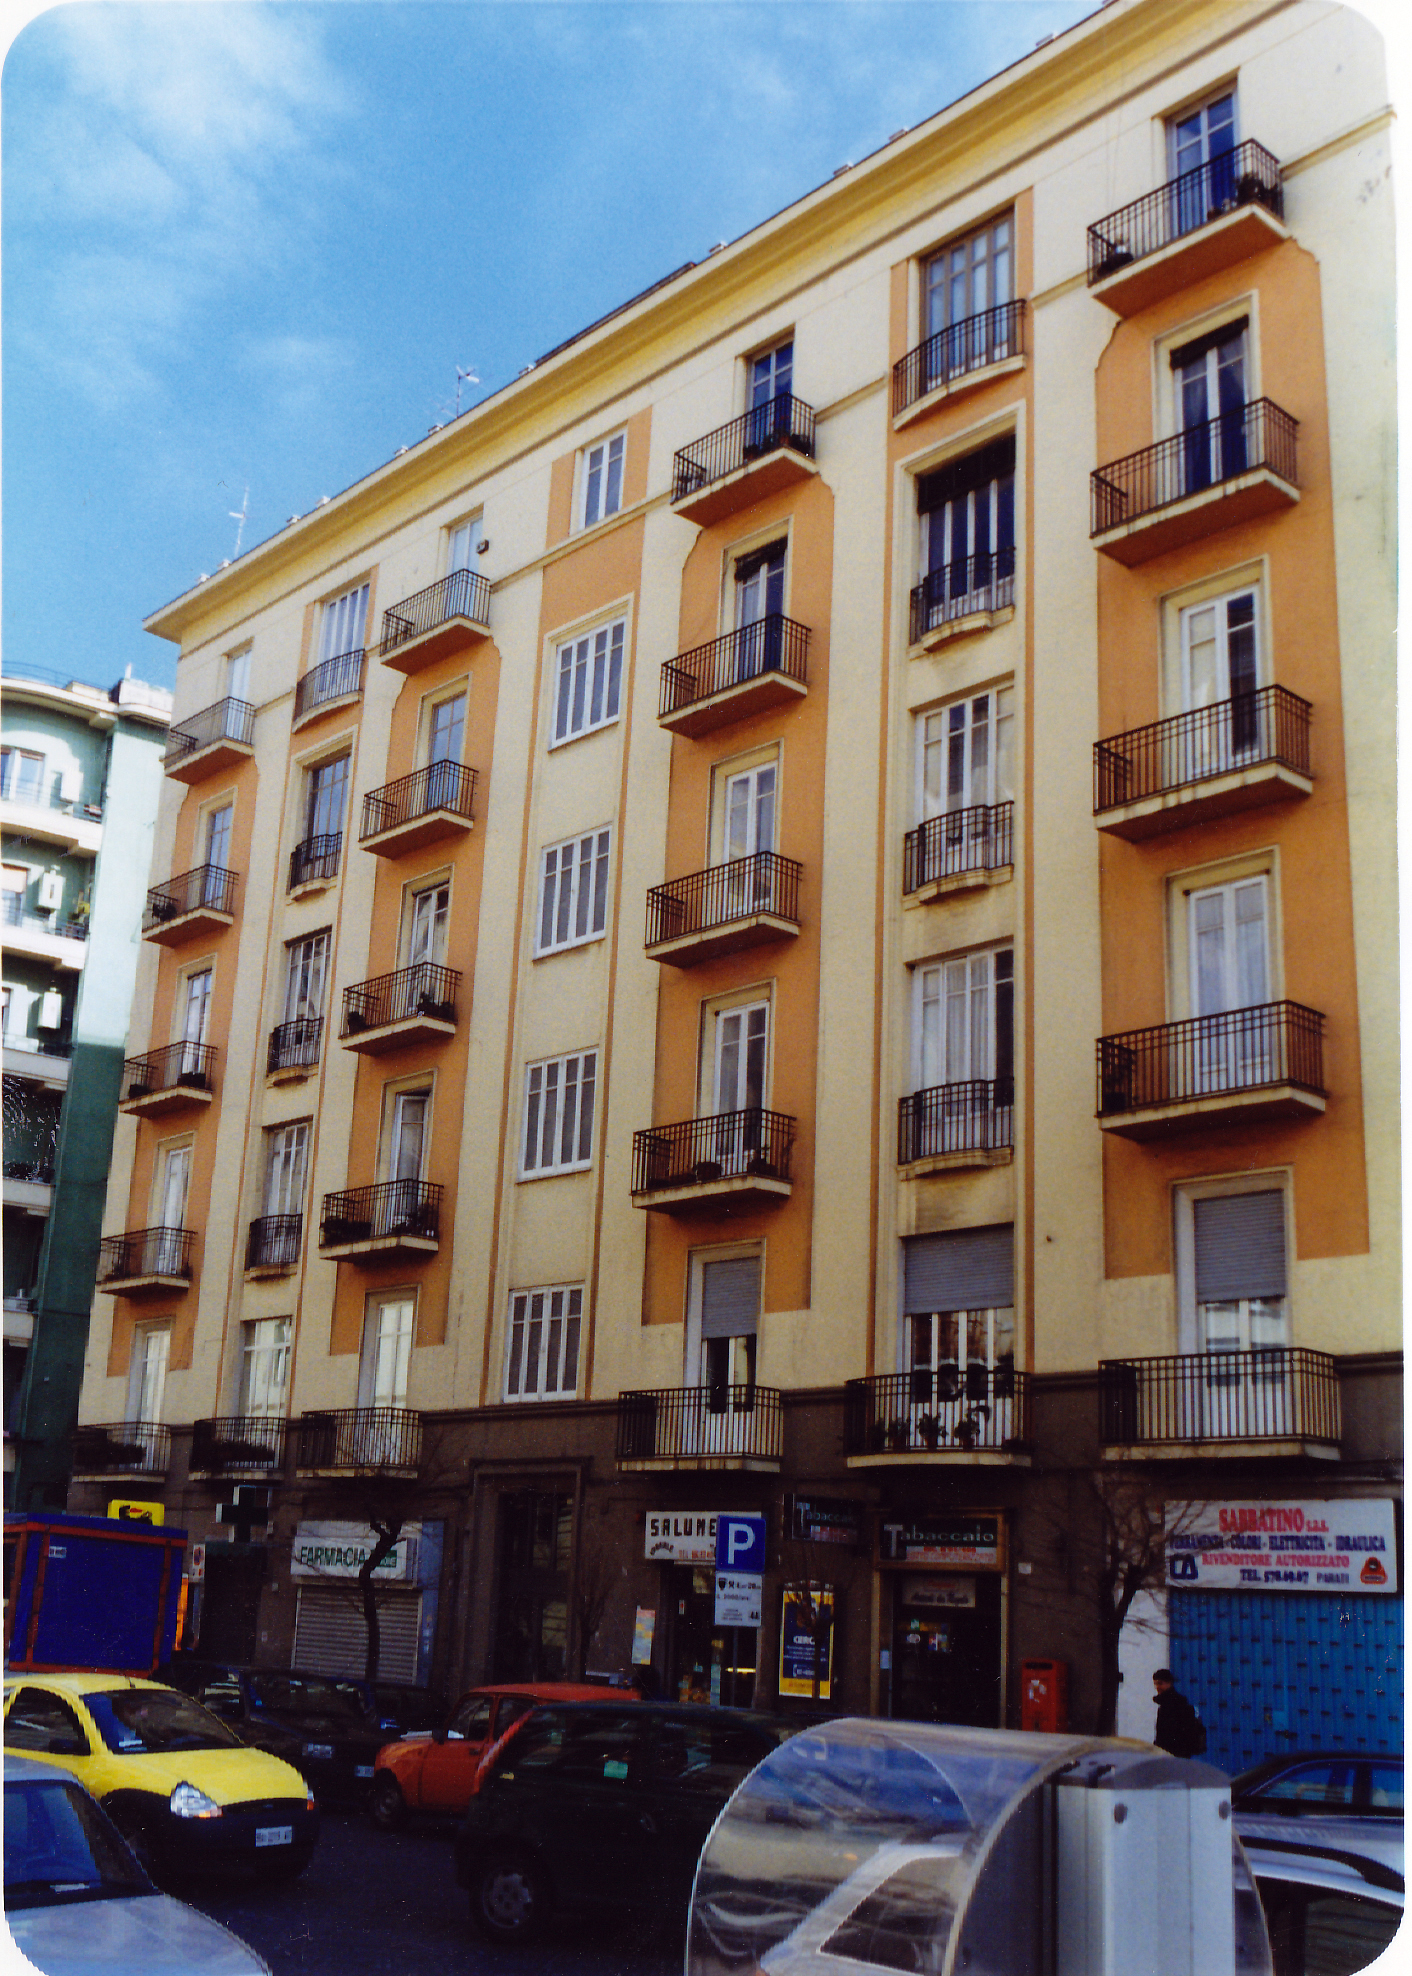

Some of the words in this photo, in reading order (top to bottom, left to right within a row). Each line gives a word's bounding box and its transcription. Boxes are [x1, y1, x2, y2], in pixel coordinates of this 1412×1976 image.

[651, 1518, 717, 1537] SALUME
[1218, 1507, 1305, 1533] SABBATINO
[728, 1523, 756, 1565] P
[883, 1524, 994, 1558] Tabaccaio
[301, 1546, 367, 1567] FARMACIA
[1202, 1553, 1272, 1567] RIVENDITORE
[1275, 1554, 1350, 1568] AUTORIZZATO
